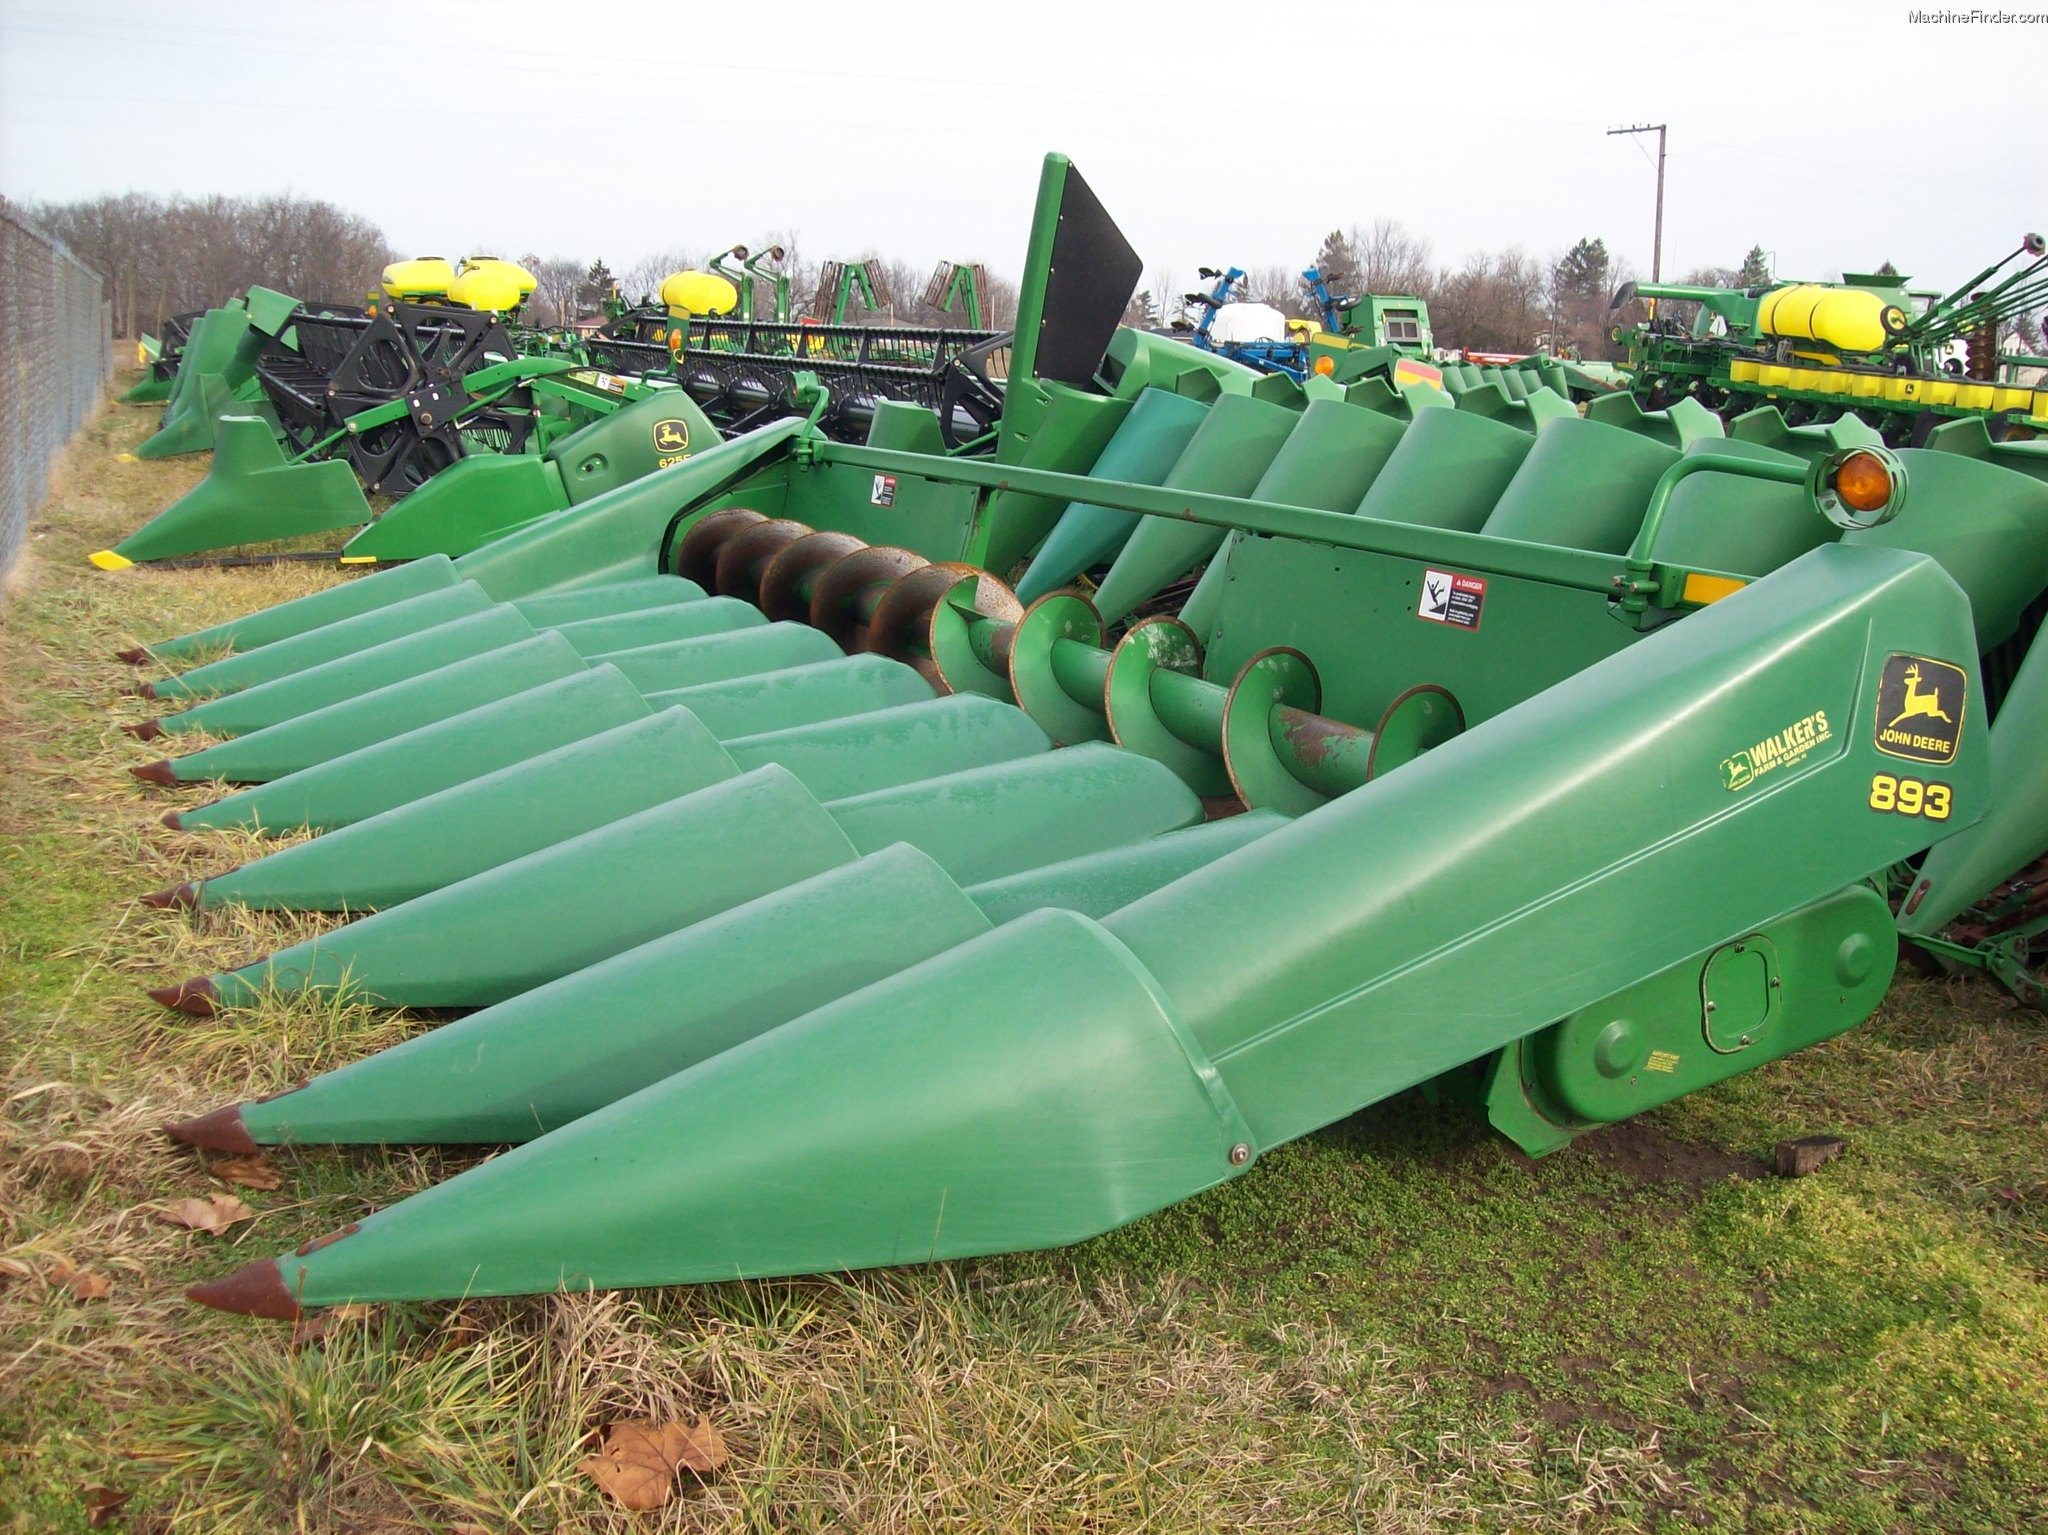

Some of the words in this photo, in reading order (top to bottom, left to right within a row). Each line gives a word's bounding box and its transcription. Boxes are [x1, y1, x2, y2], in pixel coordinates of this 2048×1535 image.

[1461, 579, 1483, 590] DANGER
[1749, 710, 1828, 767] WALKER'S
[1754, 759, 1778, 777] FARM
[1783, 738, 1816, 761] GARDEN
[1816, 730, 1833, 744] INC.
[1879, 728, 1912, 746] JOHN
[1912, 734, 1952, 754] DEERE
[1870, 775, 1951, 819] 893
